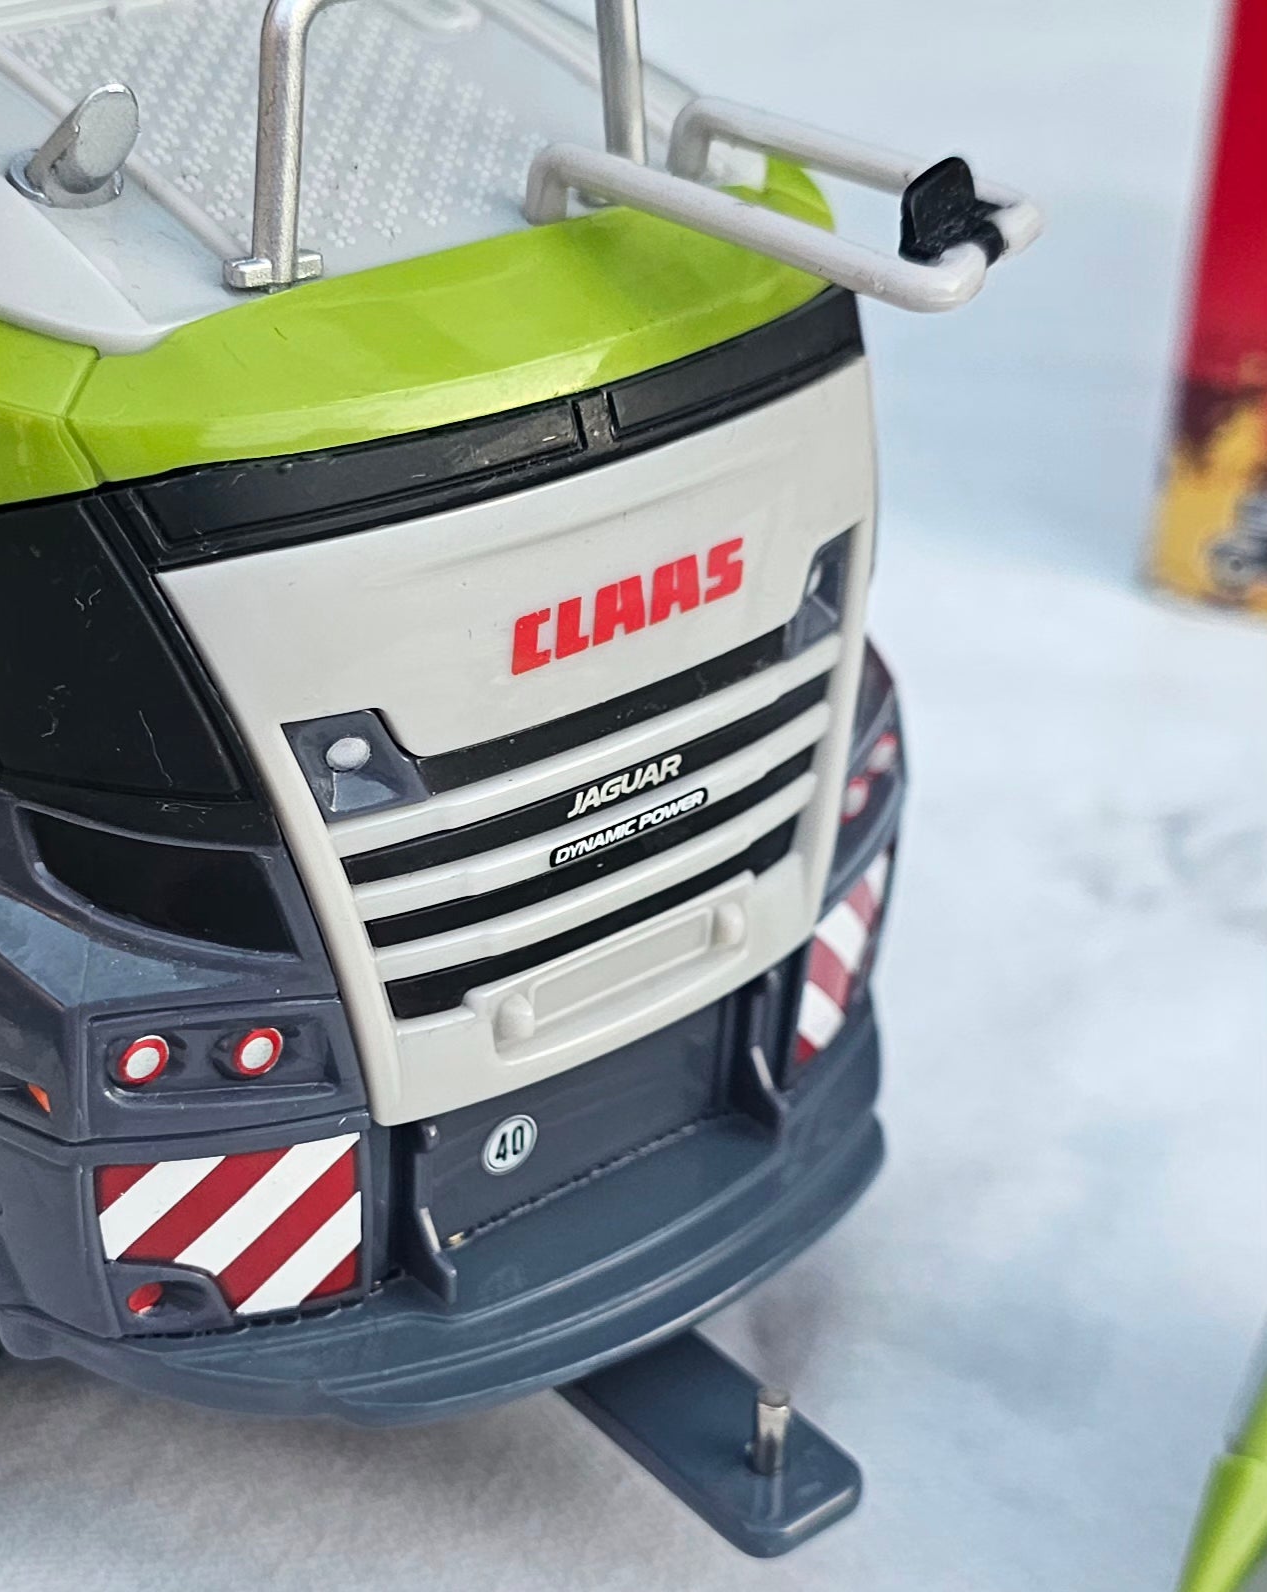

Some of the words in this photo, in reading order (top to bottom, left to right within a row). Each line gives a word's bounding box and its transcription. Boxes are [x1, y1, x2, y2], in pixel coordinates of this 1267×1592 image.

[511, 537, 743, 675] CLAAS
[567, 753, 682, 818] JAGUAR
[555, 819, 637, 865] DYNAMIC
[638, 790, 705, 830] POWER
[495, 1125, 524, 1161] 40
